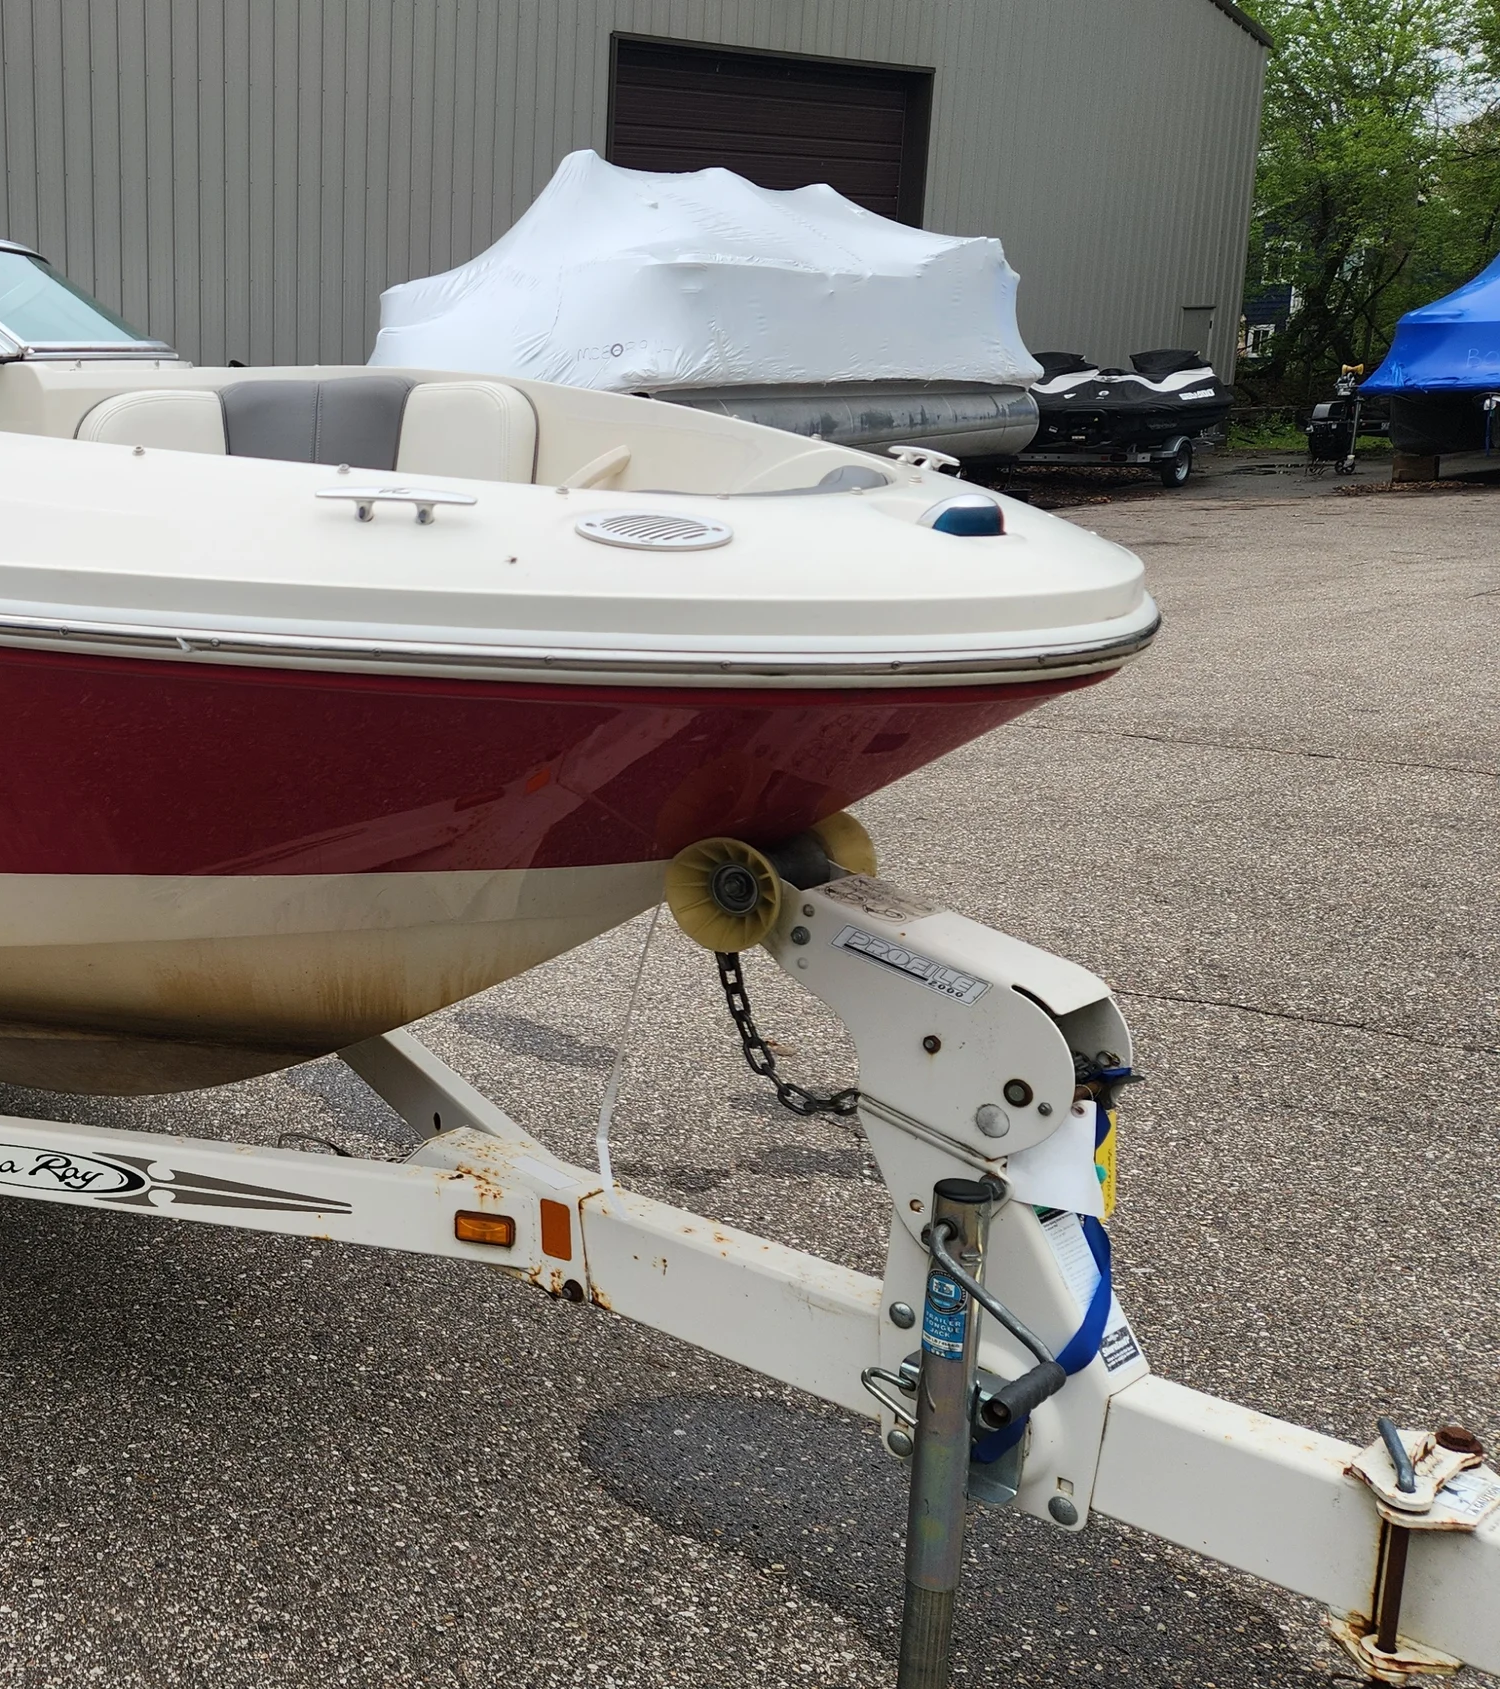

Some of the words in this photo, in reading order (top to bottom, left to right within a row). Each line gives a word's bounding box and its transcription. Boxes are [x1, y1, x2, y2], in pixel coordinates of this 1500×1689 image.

[847, 931, 977, 994] PROFILE
[928, 978, 965, 998] 2000
[28, 1153, 105, 1190] Ray
[925, 1310, 962, 1327] TRAILER
[925, 1317, 961, 1334] TONGUE
[930, 1327, 951, 1338] JACK
